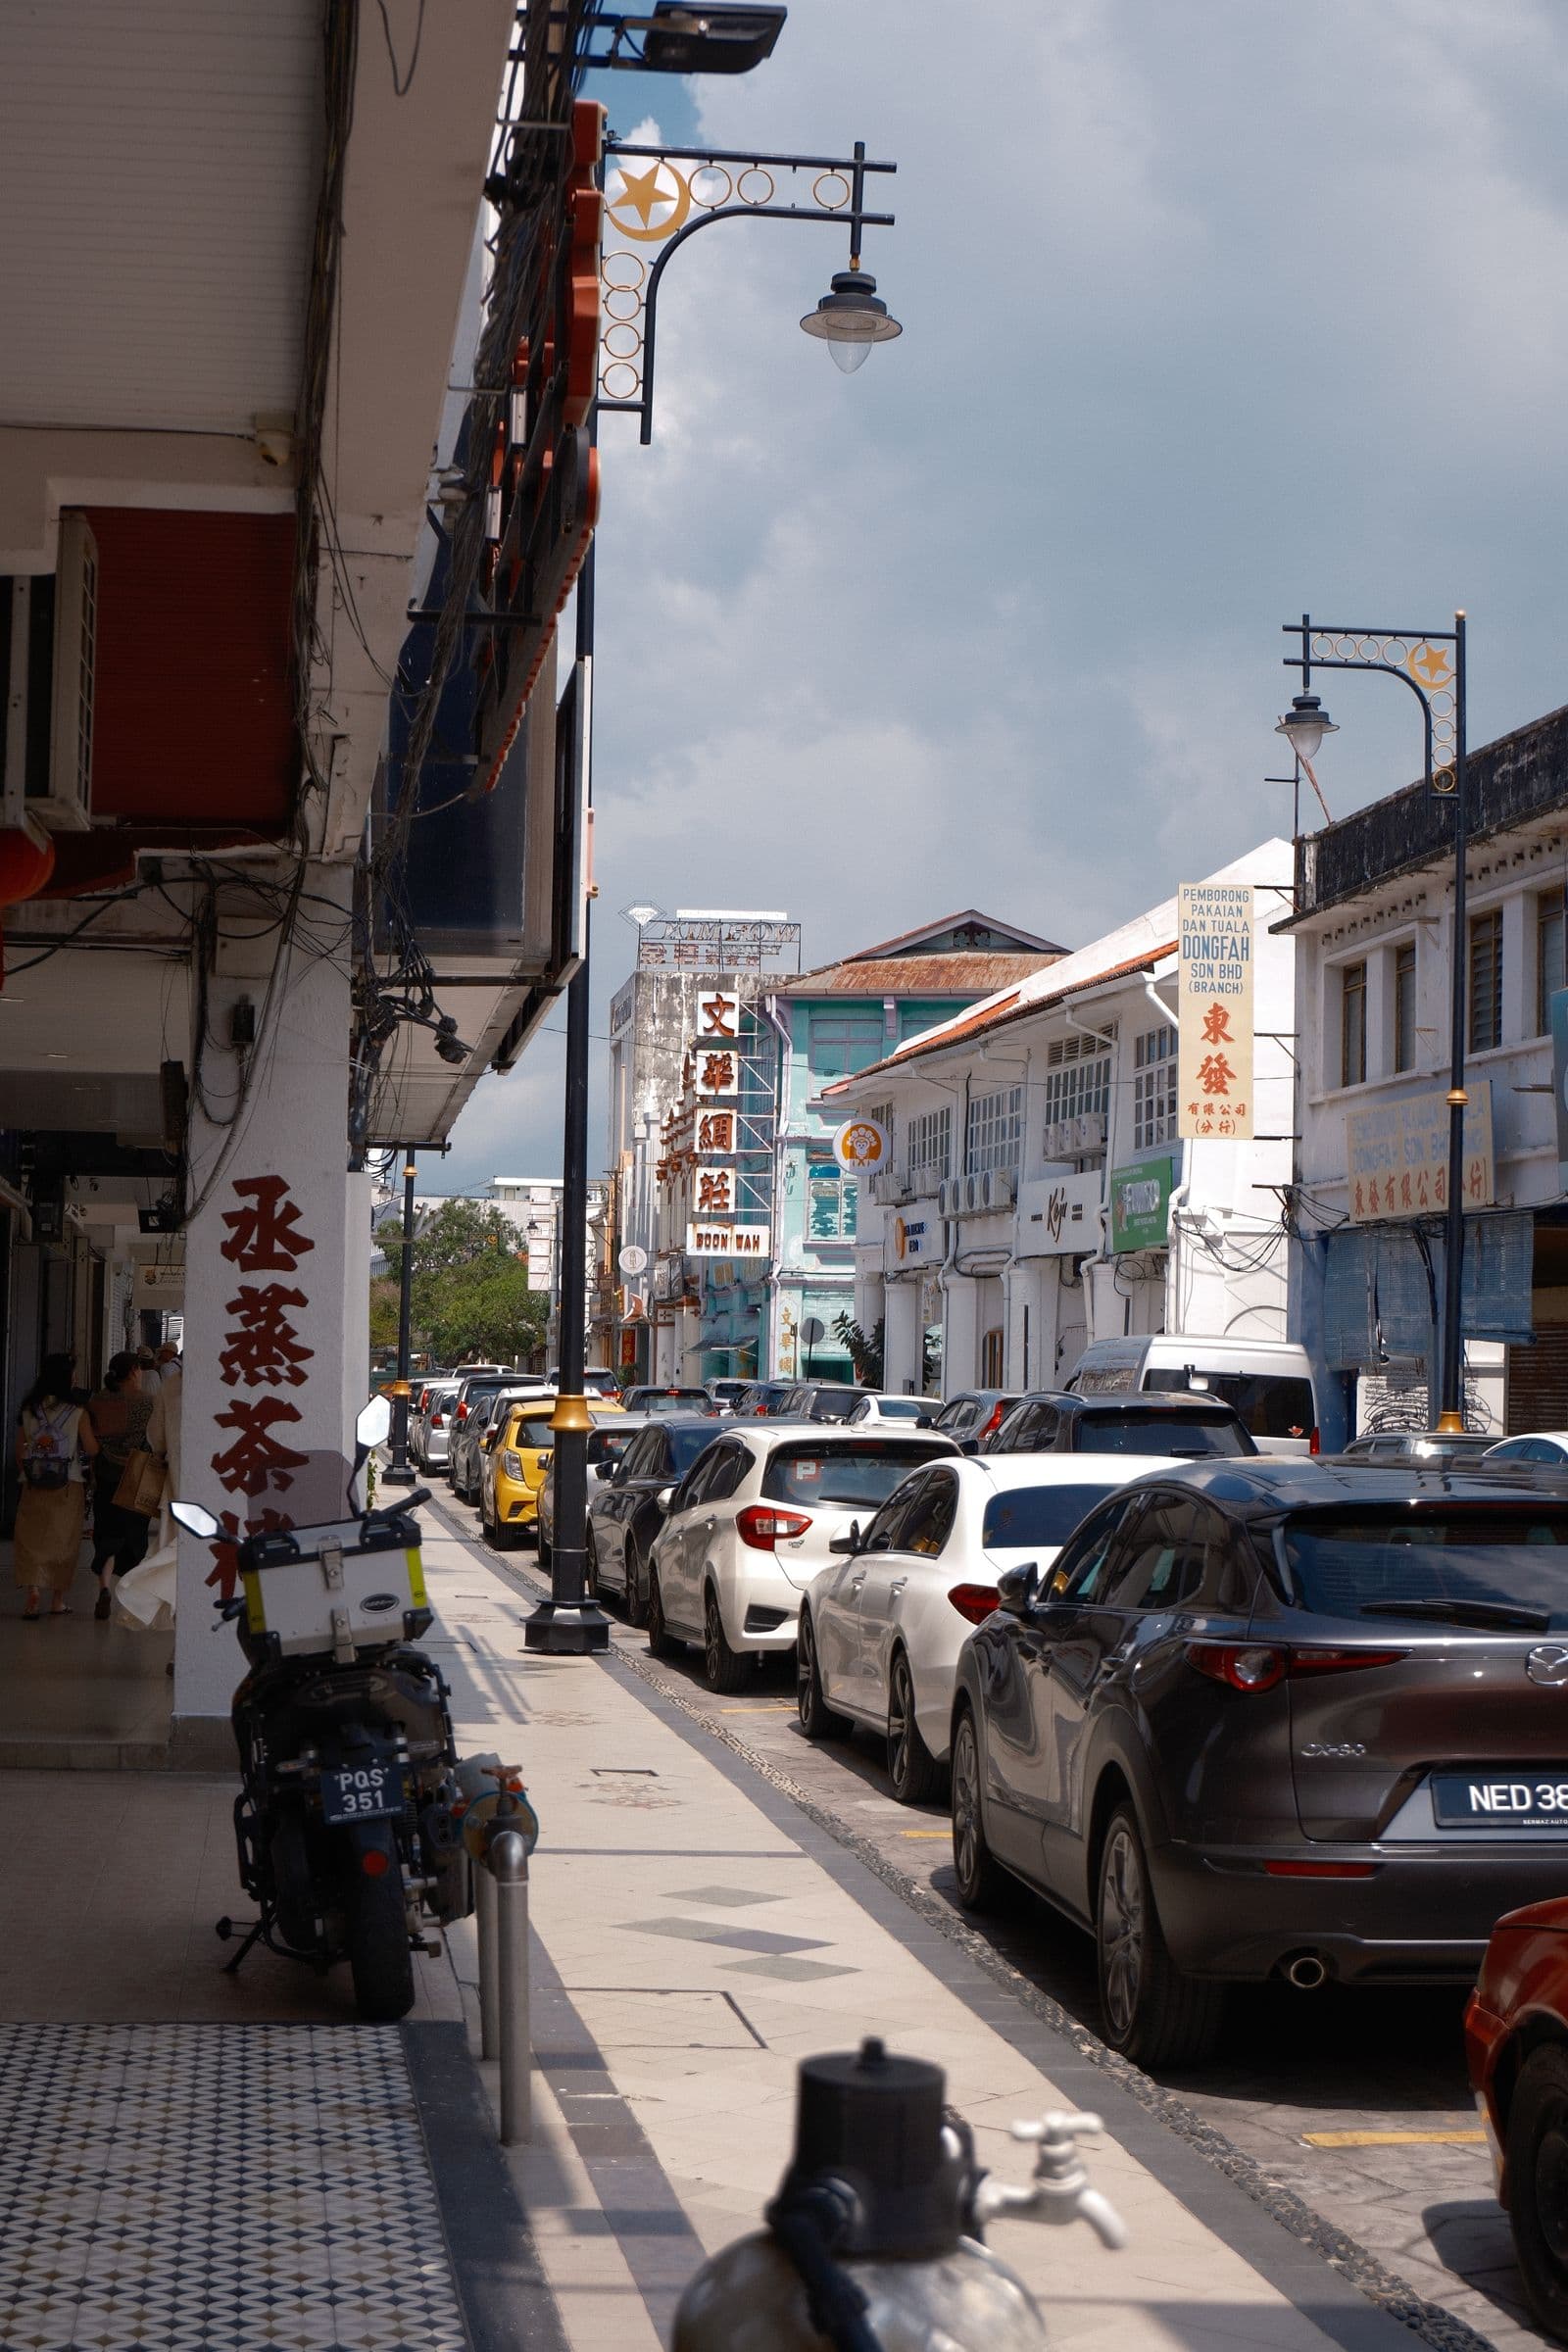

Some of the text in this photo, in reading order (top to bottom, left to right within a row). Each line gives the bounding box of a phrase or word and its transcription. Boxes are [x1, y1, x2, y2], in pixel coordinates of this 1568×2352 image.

[1183, 888, 1250, 903] PEMBORONG
[1192, 905, 1243, 917] PAKAIAN
[1183, 919, 1250, 933] DAN TUALA
[1183, 935, 1250, 961] DONGFAH
[1191, 962, 1243, 980] SDN BHD
[1189, 981, 1244, 995] (BRANCH)
[1196, 1002, 1237, 1096] 東發
[1188, 1102, 1246, 1116] 有限公司
[696, 1233, 760, 1252] BOON WAH
[339, 1768, 384, 1791] PQS
[341, 1789, 384, 1813] 351
[1468, 1784, 1533, 1812] NED
